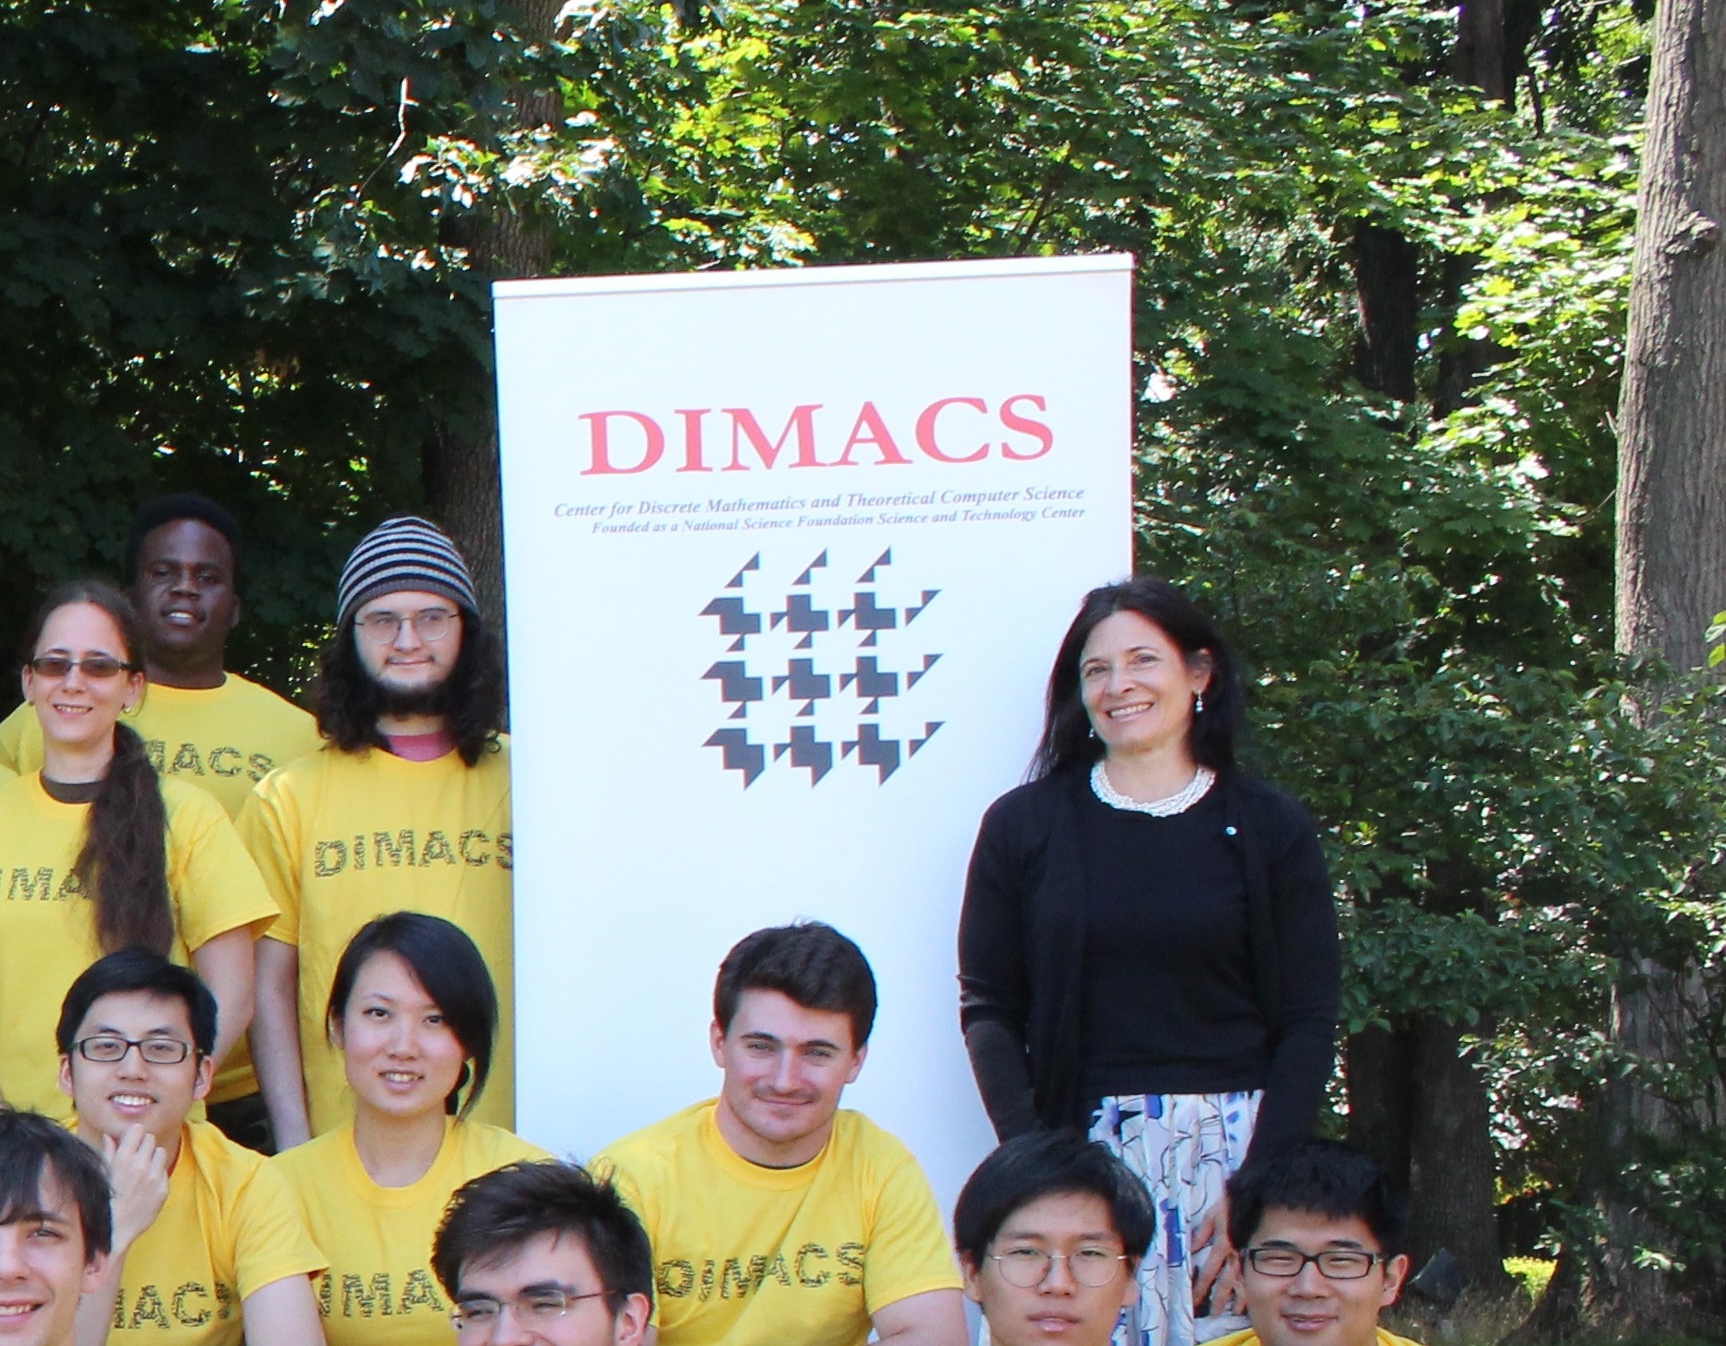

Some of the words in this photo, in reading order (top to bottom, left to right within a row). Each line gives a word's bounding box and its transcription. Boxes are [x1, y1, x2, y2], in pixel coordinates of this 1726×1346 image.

[578, 393, 1054, 476] DIMACS
[554, 502, 607, 517] Center
[609, 501, 633, 519] for
[637, 500, 701, 515] Discrete
[706, 496, 805, 513] Mathematics
[810, 494, 841, 508] and
[846, 491, 935, 508] Theoretical
[940, 490, 1019, 507] Computer
[1023, 487, 1084, 502] Science
[592, 520, 650, 534] Founded
[652, 523, 667, 533] as
[670, 523, 678, 532] a
[682, 518, 738, 532] National
[741, 517, 793, 530] Science
[797, 514, 874, 528] Foundation
[877, 511, 927, 525] Science
[931, 510, 957, 523] and
[961, 508, 1037, 522] Technology
[1041, 506, 1085, 519] Center
[315, 829, 514, 878] DIMACS
[319, 1269, 444, 1317] IMA
[657, 1242, 866, 1301] DIMACS
